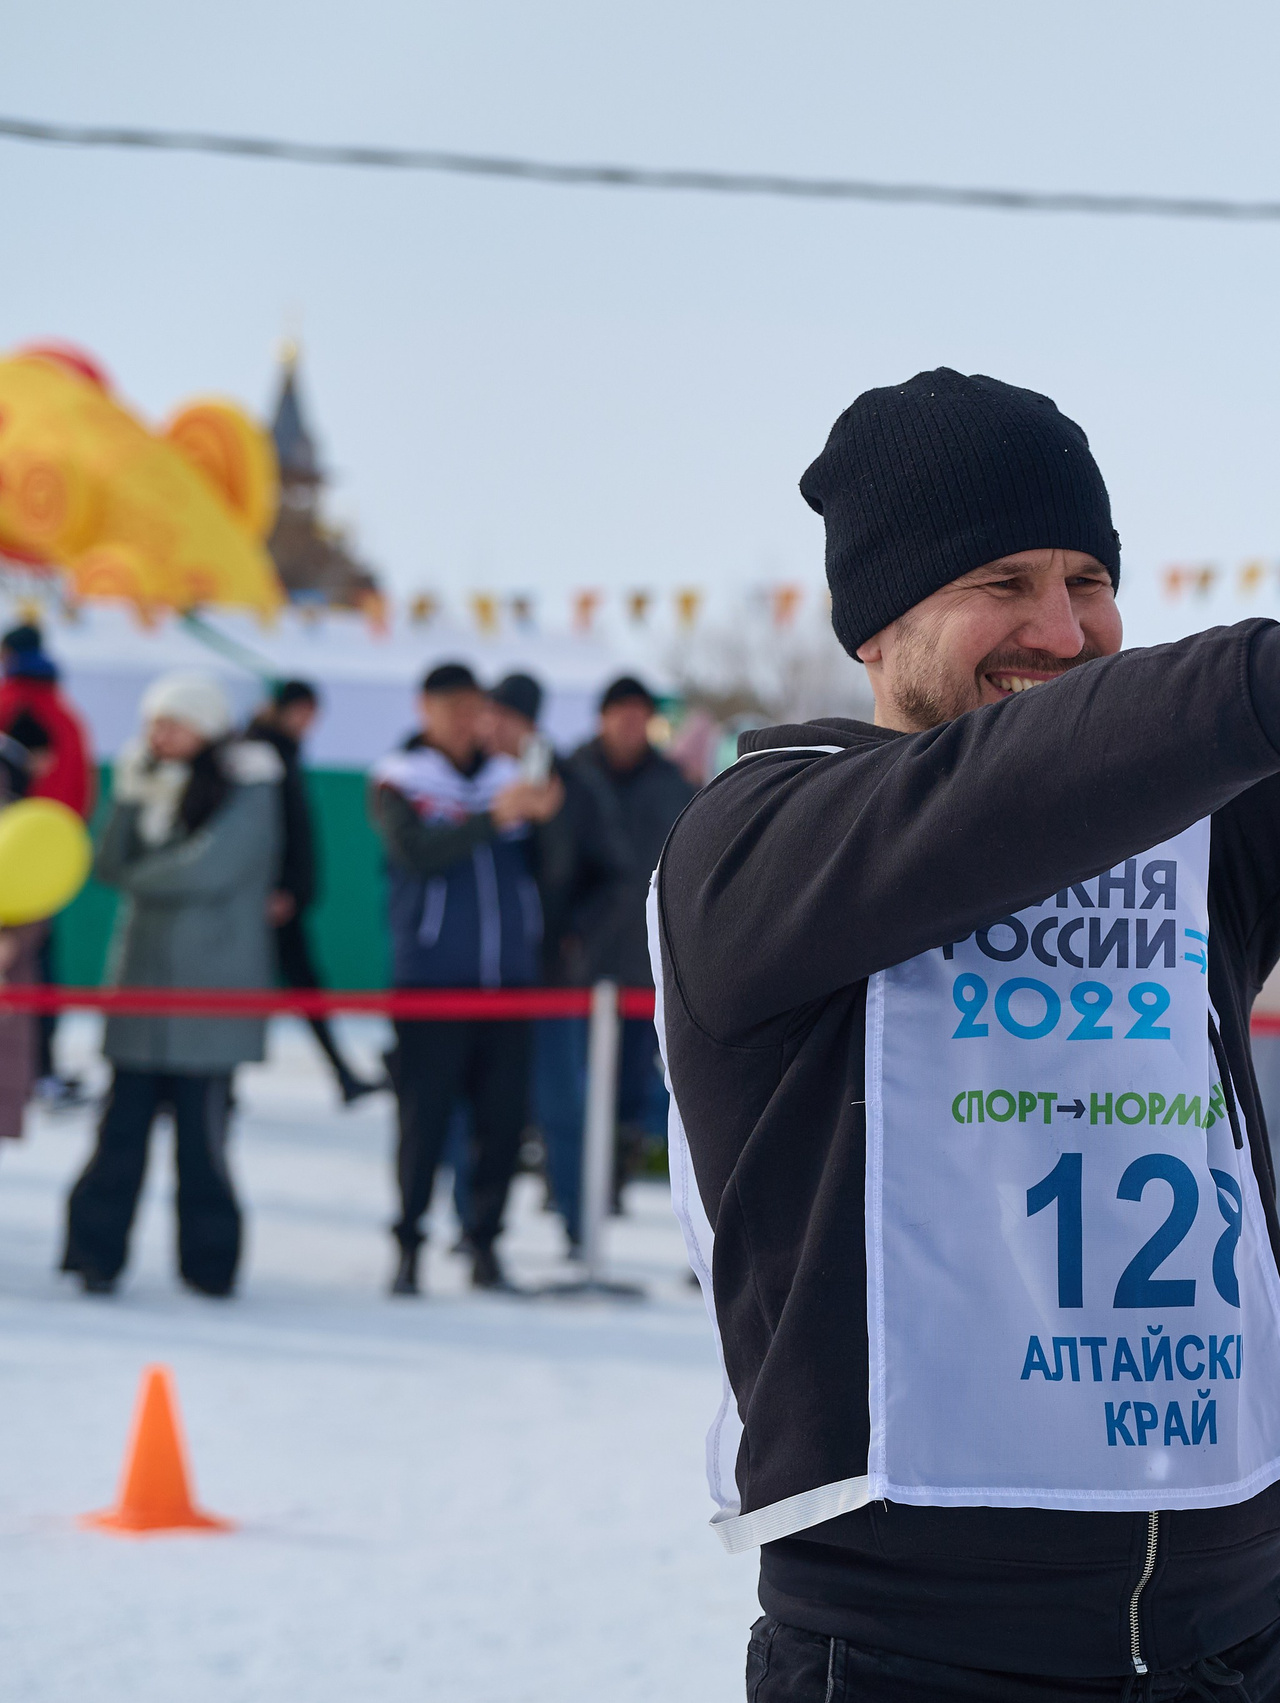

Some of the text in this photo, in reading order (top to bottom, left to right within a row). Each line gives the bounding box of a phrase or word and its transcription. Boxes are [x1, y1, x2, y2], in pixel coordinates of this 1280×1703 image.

[1032, 858, 1178, 911] НЯ
[951, 972, 1171, 1041] 2022
[951, 1089, 1058, 1125] СПОРТ
[1090, 1091, 1208, 1129] НОРМ
[1020, 1324, 1242, 1382] АЛТАЙСК
[1104, 1388, 1218, 1447] КРАЙ
